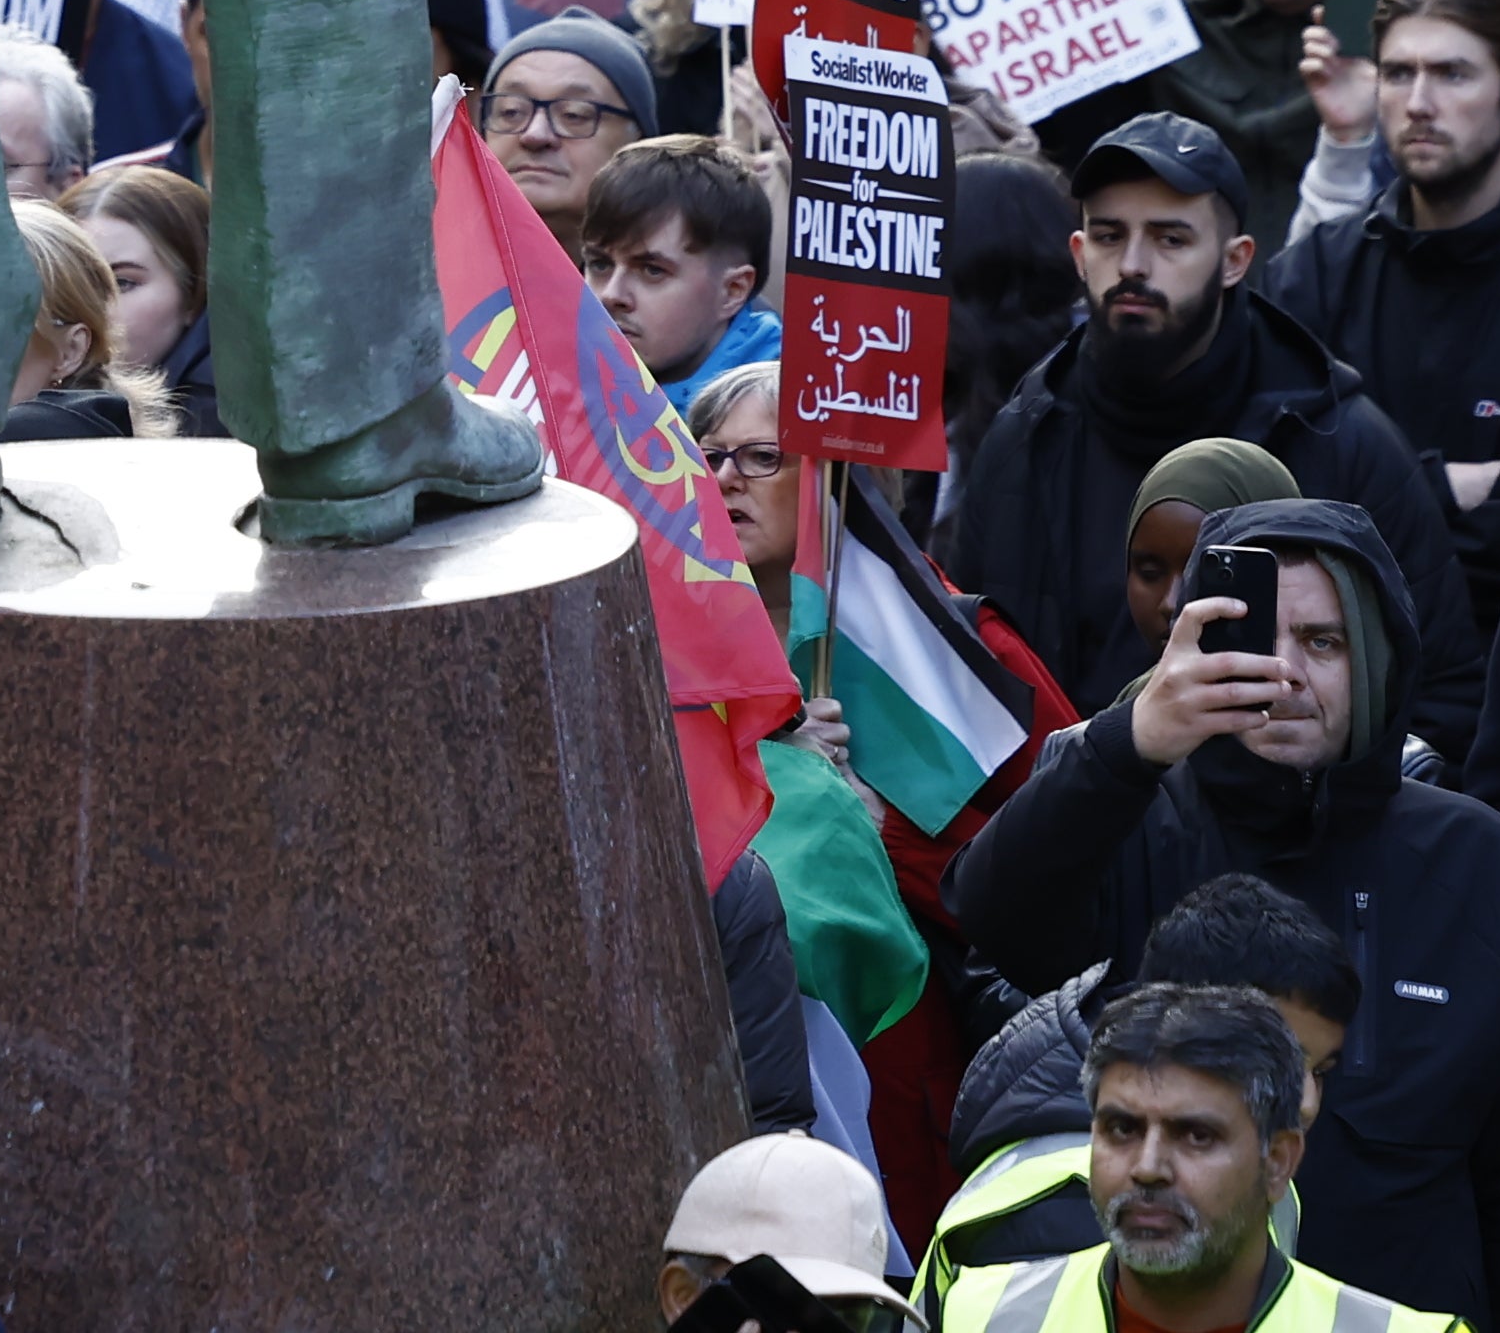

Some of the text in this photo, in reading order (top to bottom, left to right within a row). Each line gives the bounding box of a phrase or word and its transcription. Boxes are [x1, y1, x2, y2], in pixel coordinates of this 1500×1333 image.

[811, 51, 929, 94] Socialist Worker
[991, 17, 1142, 102] ISRAEL
[804, 96, 940, 180] FREEDOM
[851, 170, 879, 204] for
[793, 196, 945, 280] PALESTINE
[810, 294, 911, 364] الحرية
[797, 363, 920, 424] لفلسطين
[1401, 983, 1445, 1002] AIRMAX
